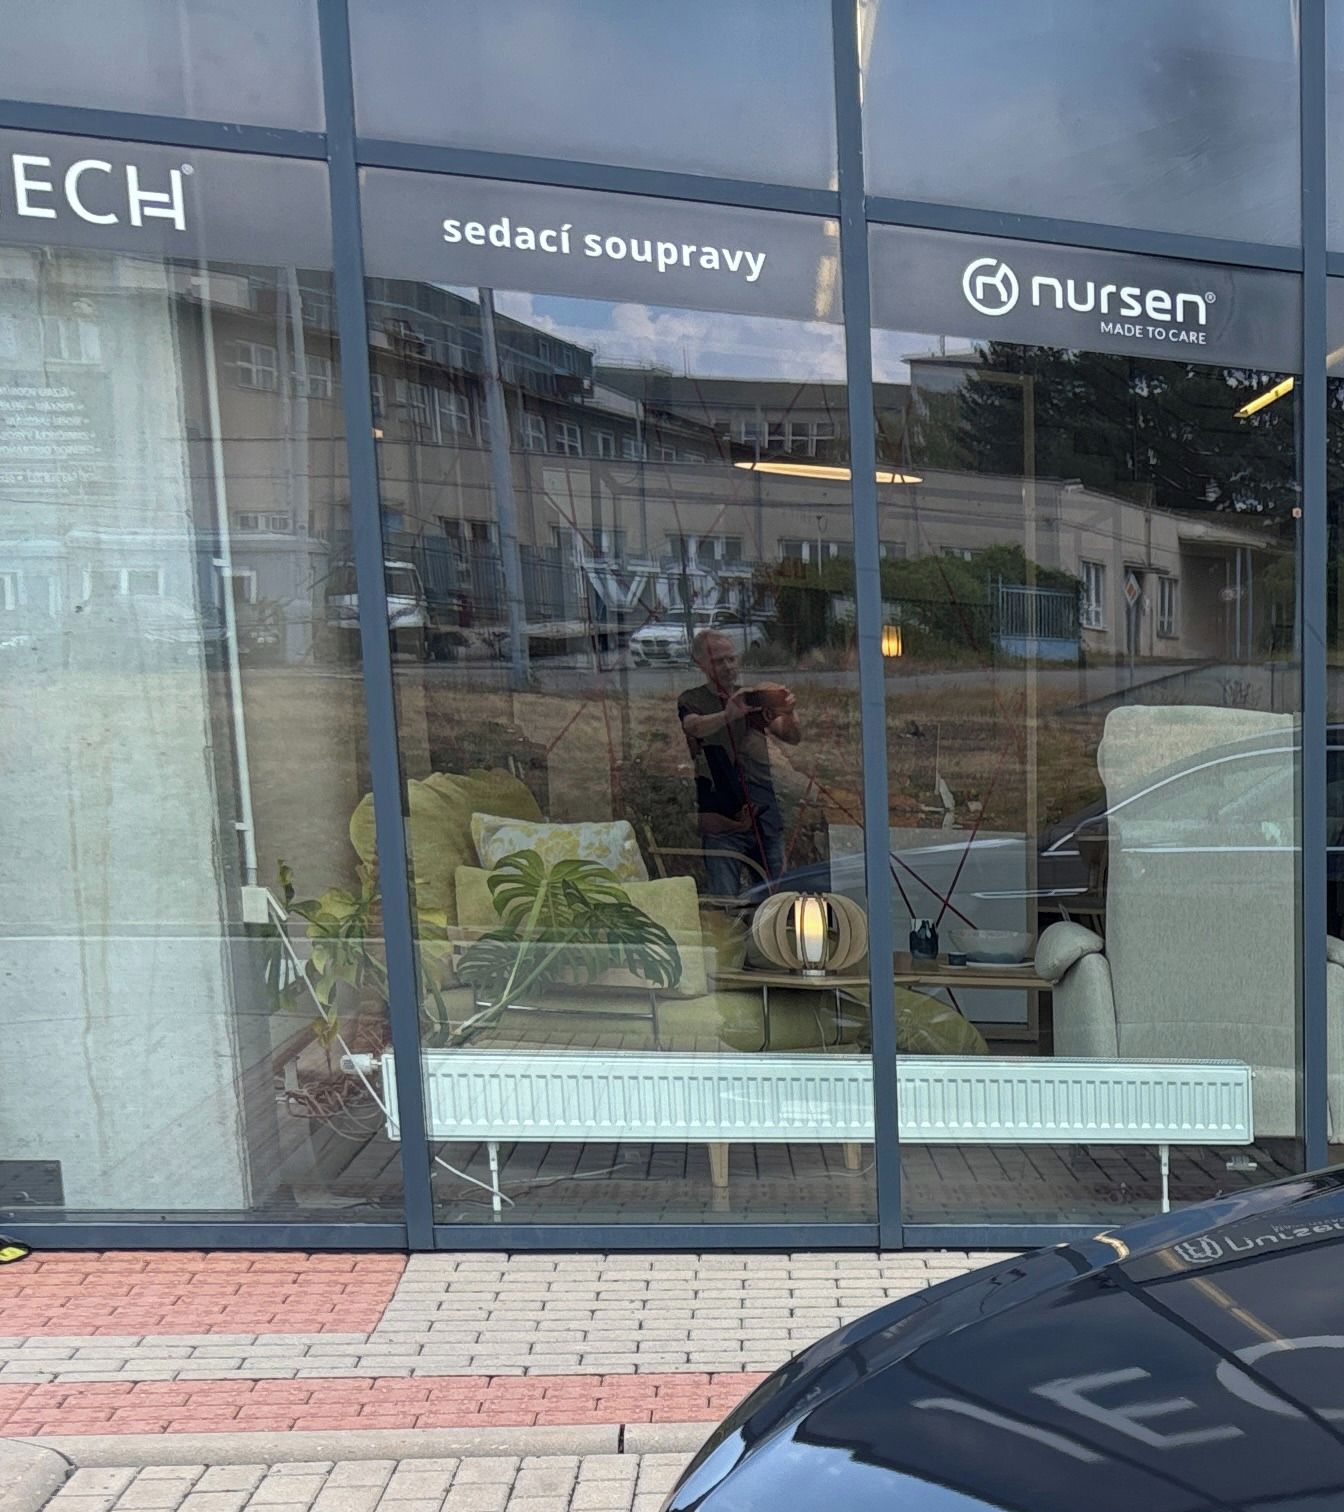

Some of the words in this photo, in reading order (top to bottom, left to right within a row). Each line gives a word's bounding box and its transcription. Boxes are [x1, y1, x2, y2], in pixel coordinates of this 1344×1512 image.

[443, 216, 572, 254] sedací
[584, 234, 766, 282] soupravy
[1032, 275, 1208, 325] nursen
[1100, 321, 1144, 338] MADE
[1146, 326, 1166, 340] TO
[1168, 329, 1207, 345] CARE
